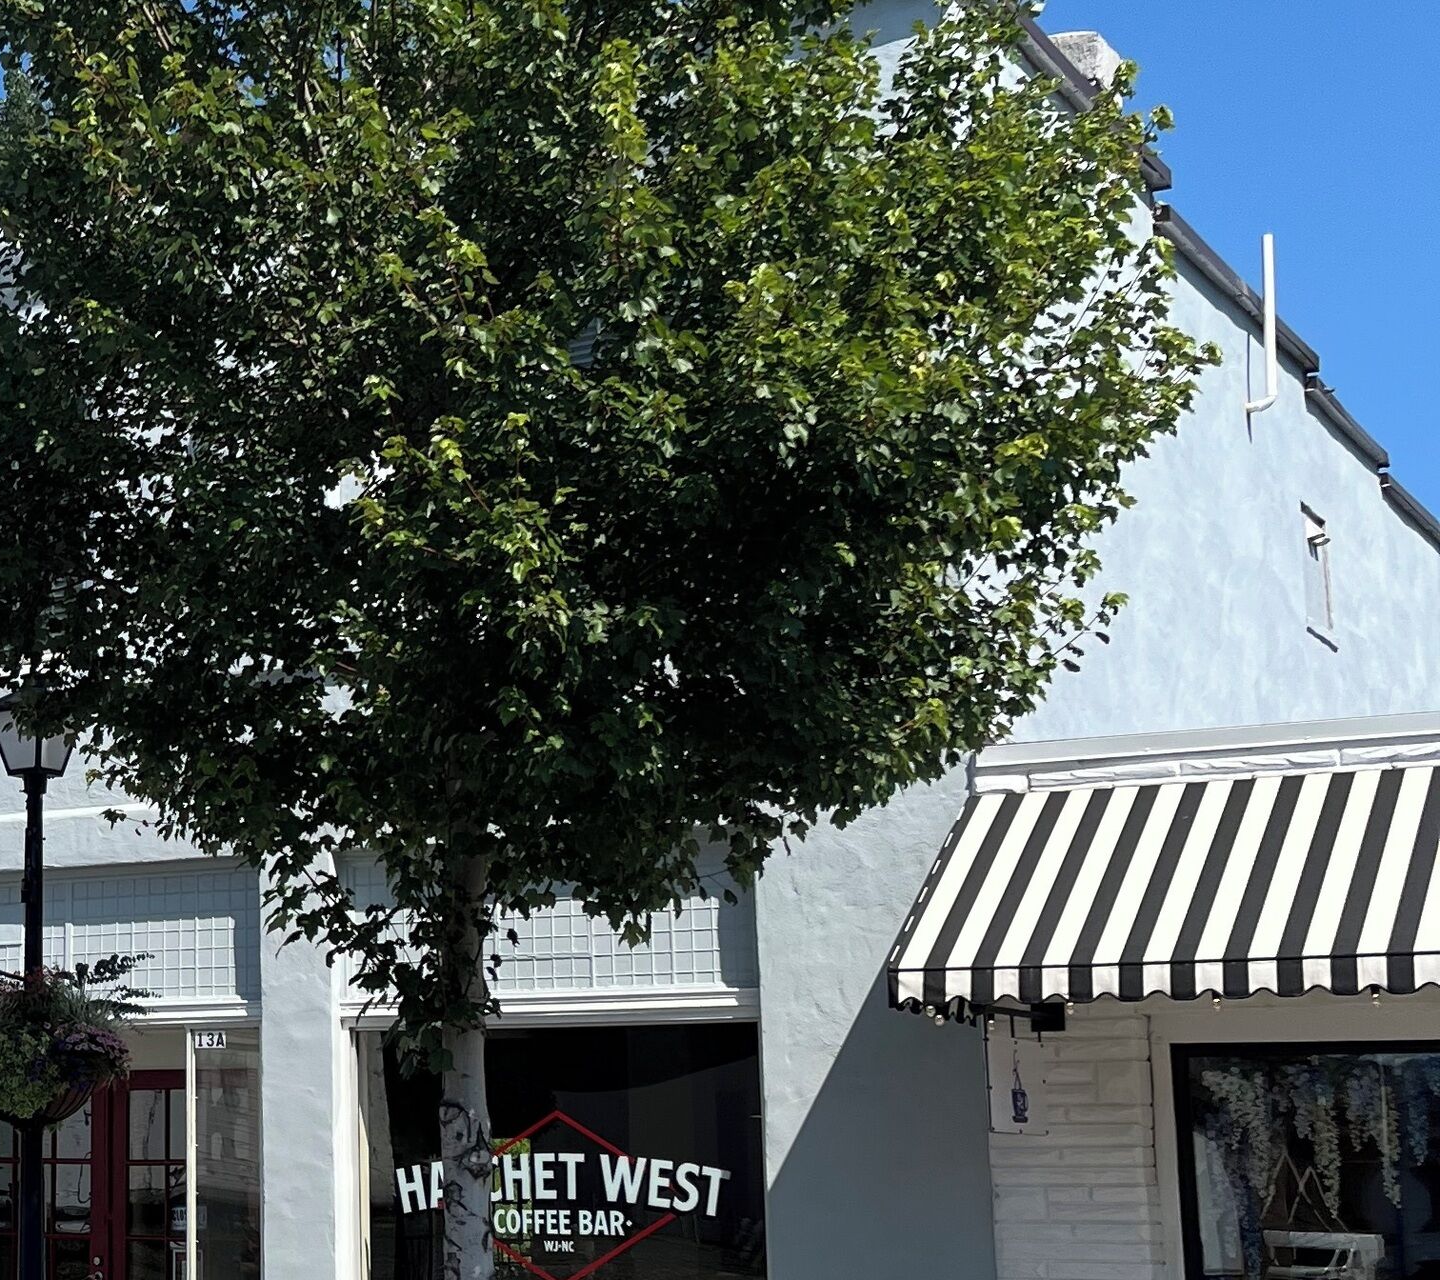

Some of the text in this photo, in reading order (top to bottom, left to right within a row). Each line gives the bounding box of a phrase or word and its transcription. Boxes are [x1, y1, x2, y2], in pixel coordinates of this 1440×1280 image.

[197, 1032, 225, 1047] 13A
[396, 1152, 731, 1217] HACHET WEST
[493, 1209, 572, 1235] COFFEE
